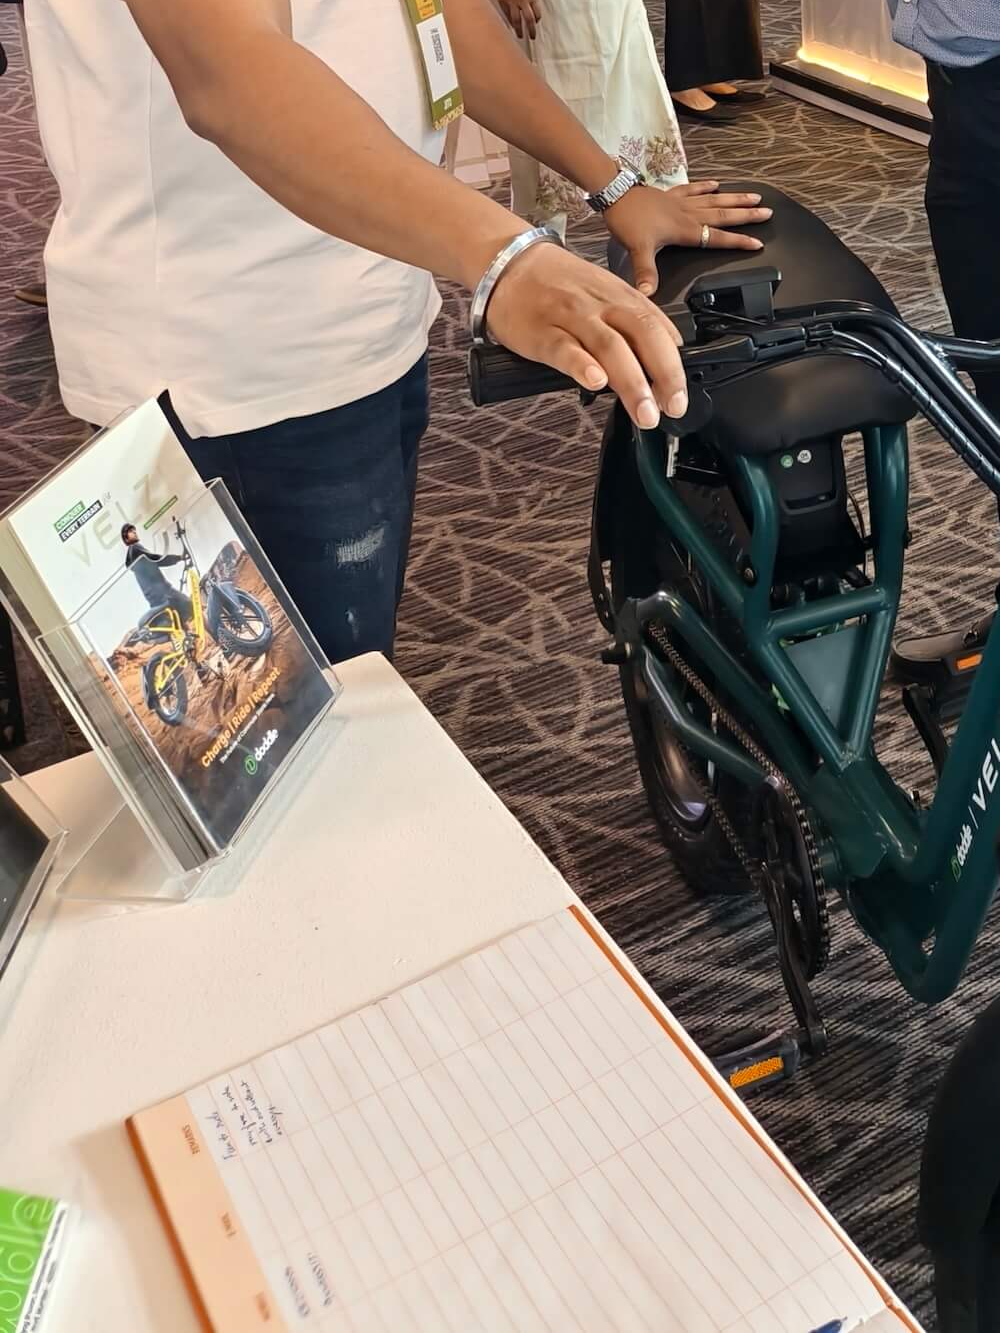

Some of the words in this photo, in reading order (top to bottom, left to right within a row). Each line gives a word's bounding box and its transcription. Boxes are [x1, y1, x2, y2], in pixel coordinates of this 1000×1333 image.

[201, 729, 232, 767] Charge
[232, 704, 252, 729] Ride
[252, 666, 281, 704] Repeat
[182, 1124, 200, 1155] REMARKS
